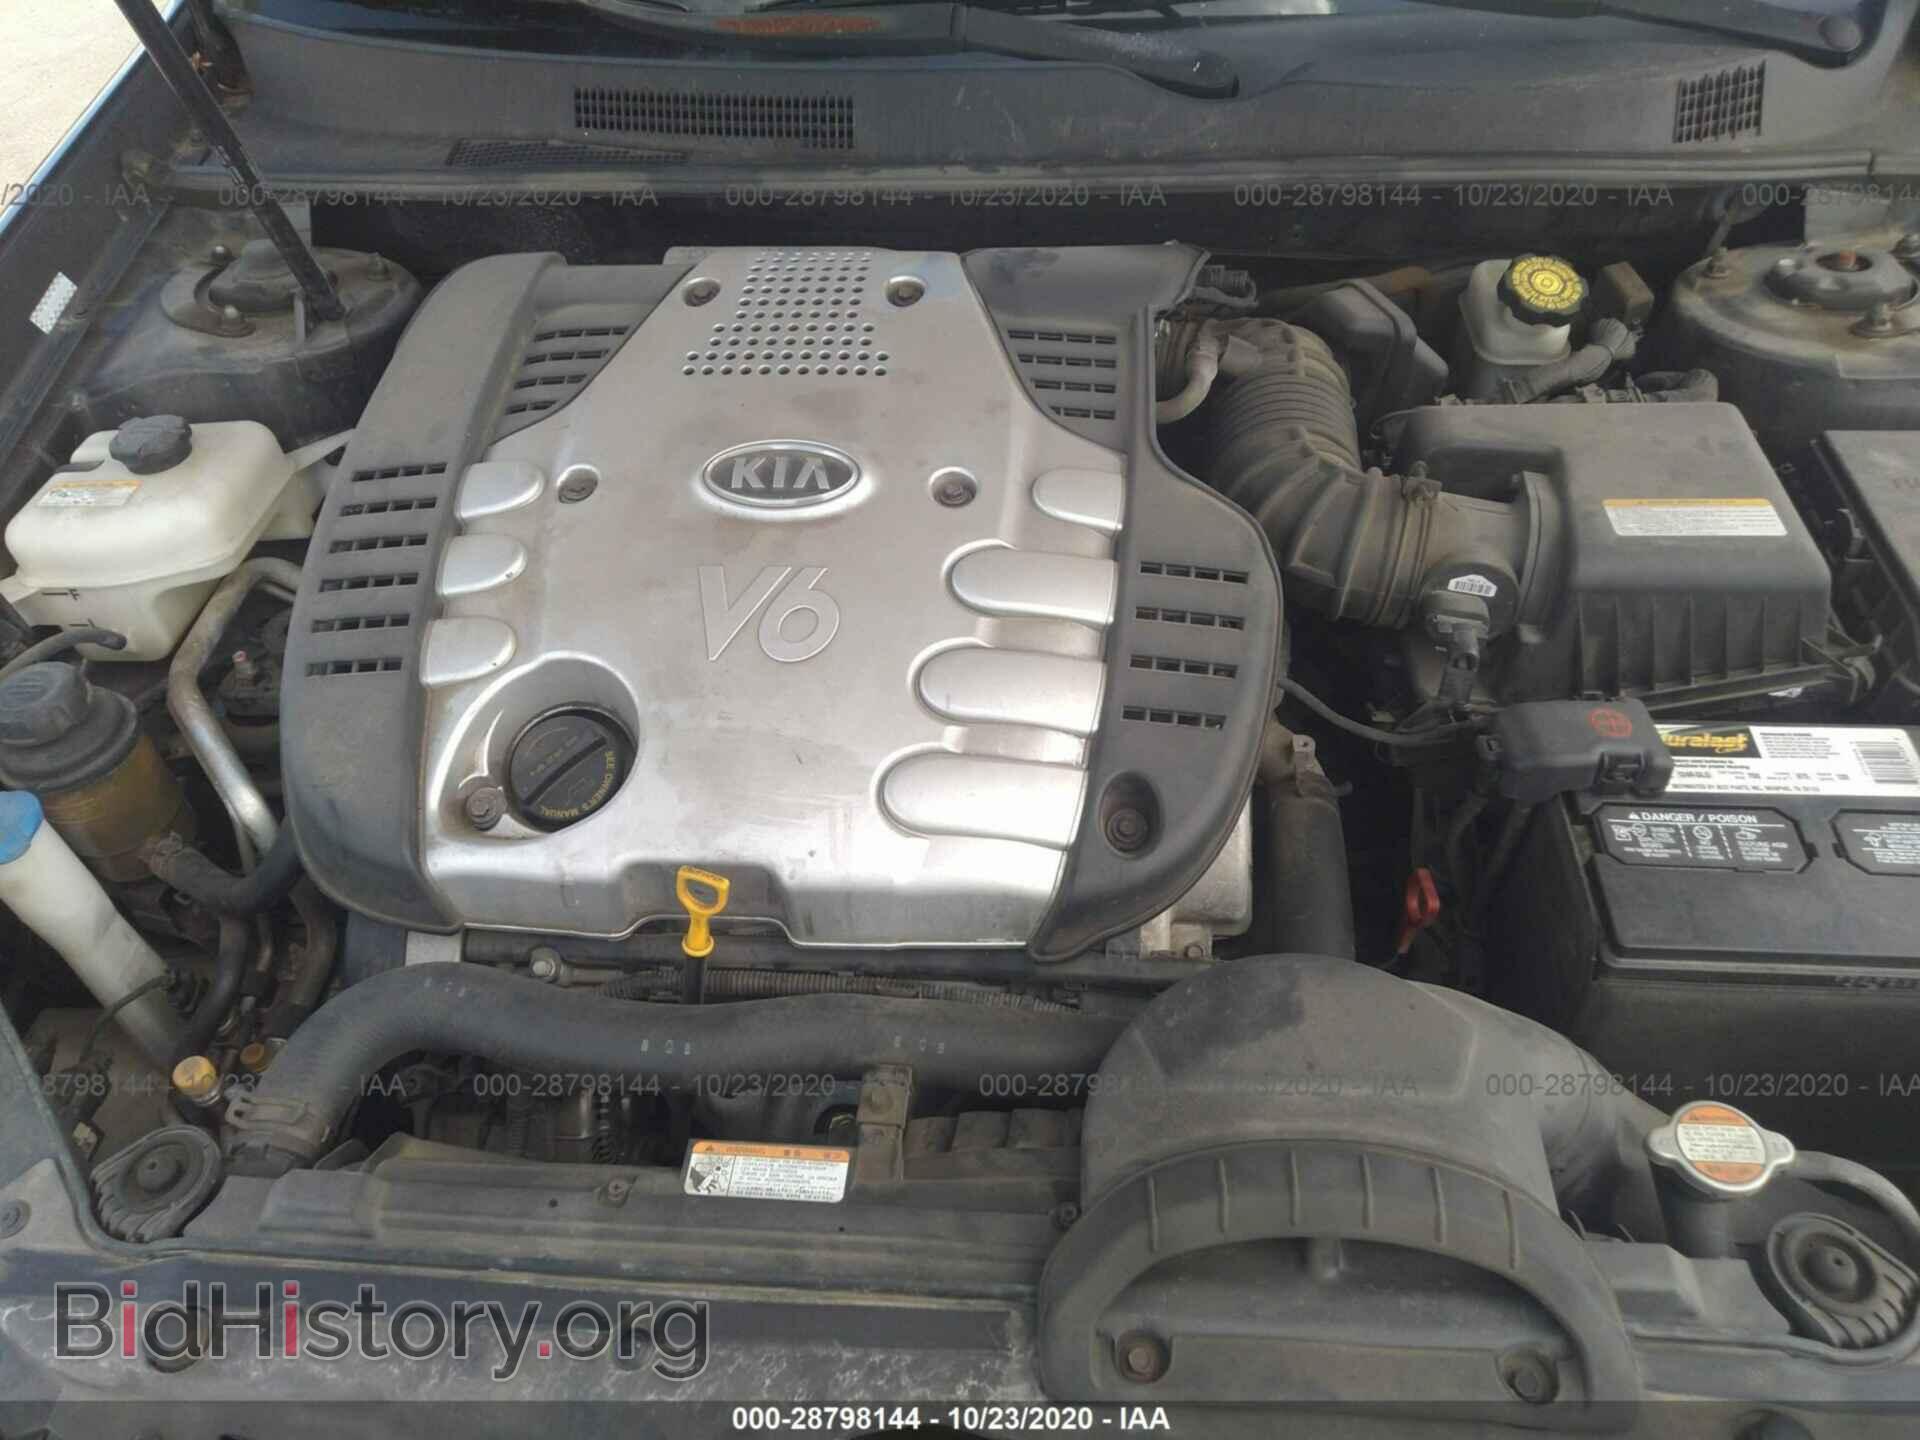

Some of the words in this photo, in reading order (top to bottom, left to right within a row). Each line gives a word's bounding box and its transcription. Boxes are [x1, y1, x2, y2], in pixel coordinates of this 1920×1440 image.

[731, 457, 831, 490] KIA
[697, 564, 841, 664] V6
[1641, 811, 1696, 823] DANGER
[1707, 813, 1759, 825] POISON
